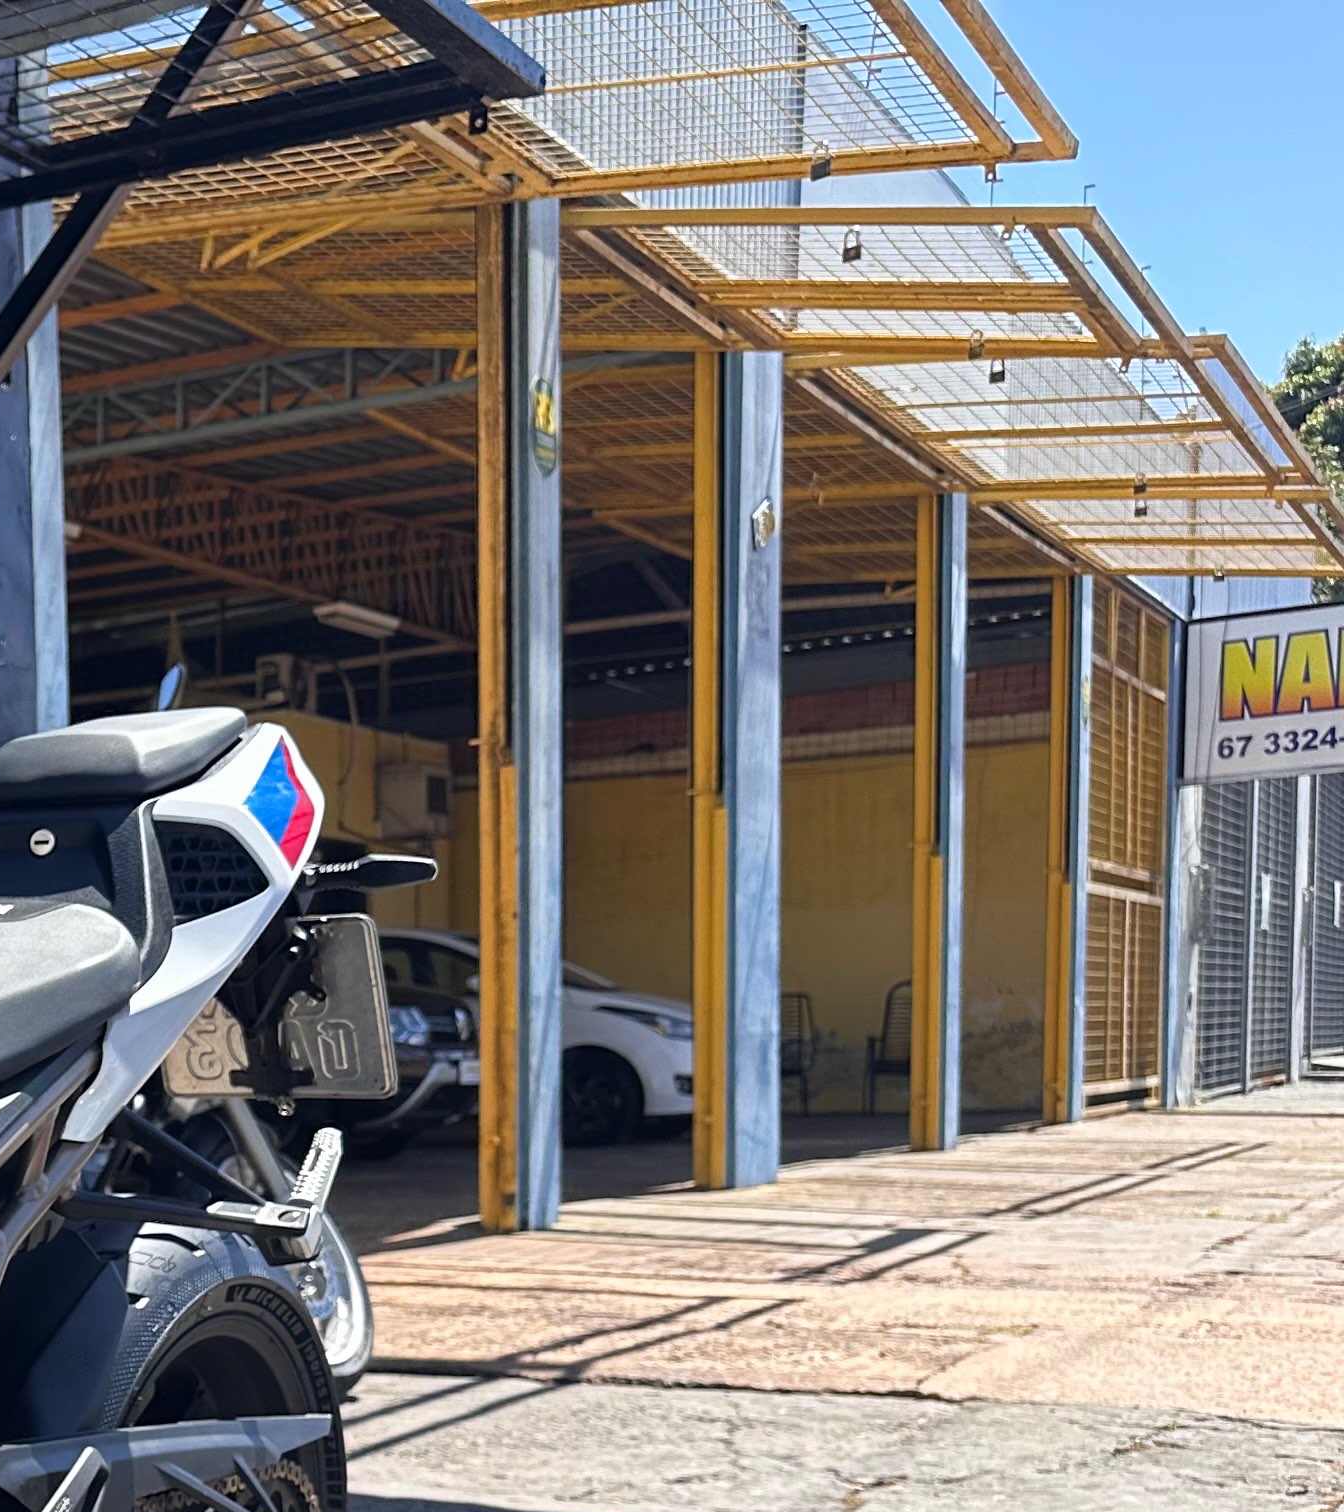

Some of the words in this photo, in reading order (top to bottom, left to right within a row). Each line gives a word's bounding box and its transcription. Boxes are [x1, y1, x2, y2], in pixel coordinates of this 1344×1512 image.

[1219, 627, 1344, 722] NA
[1217, 736, 1253, 759] 67
[248, 1285, 305, 1337] MICHELIN
